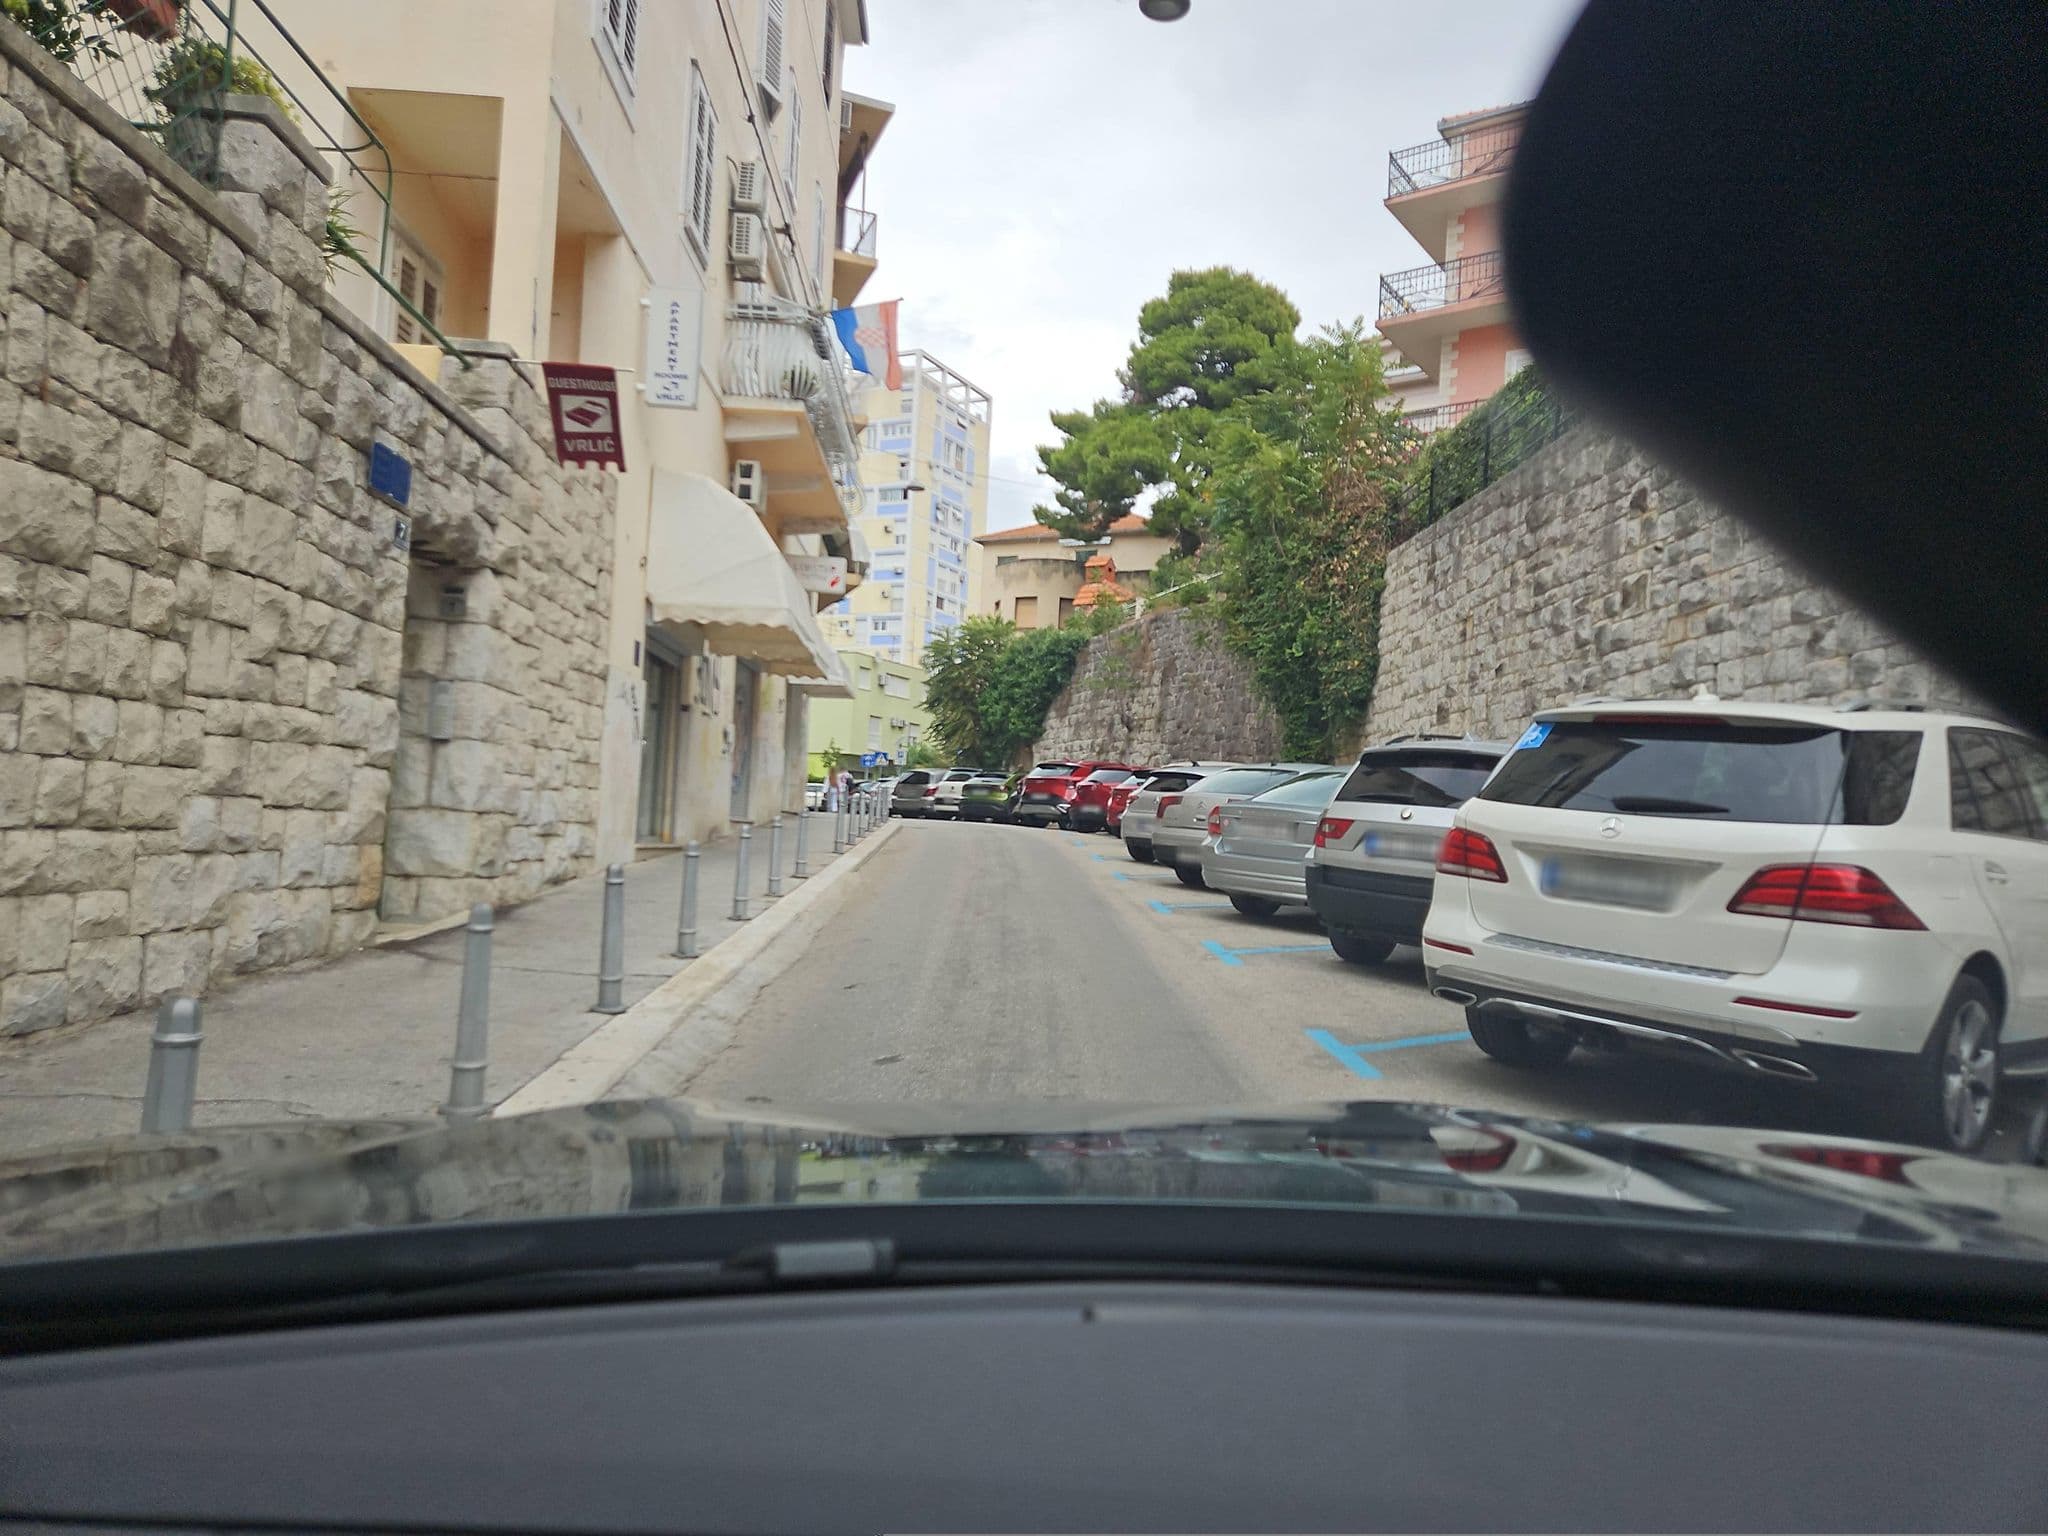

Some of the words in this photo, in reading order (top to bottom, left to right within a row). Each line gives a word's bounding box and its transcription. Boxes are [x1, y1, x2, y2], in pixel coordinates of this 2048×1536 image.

[668, 301, 680, 371] APARTMENT
[548, 376, 617, 393] GUESTHOUSE
[563, 436, 616, 454] VRLIĆ
[399, 522, 406, 539] 7
